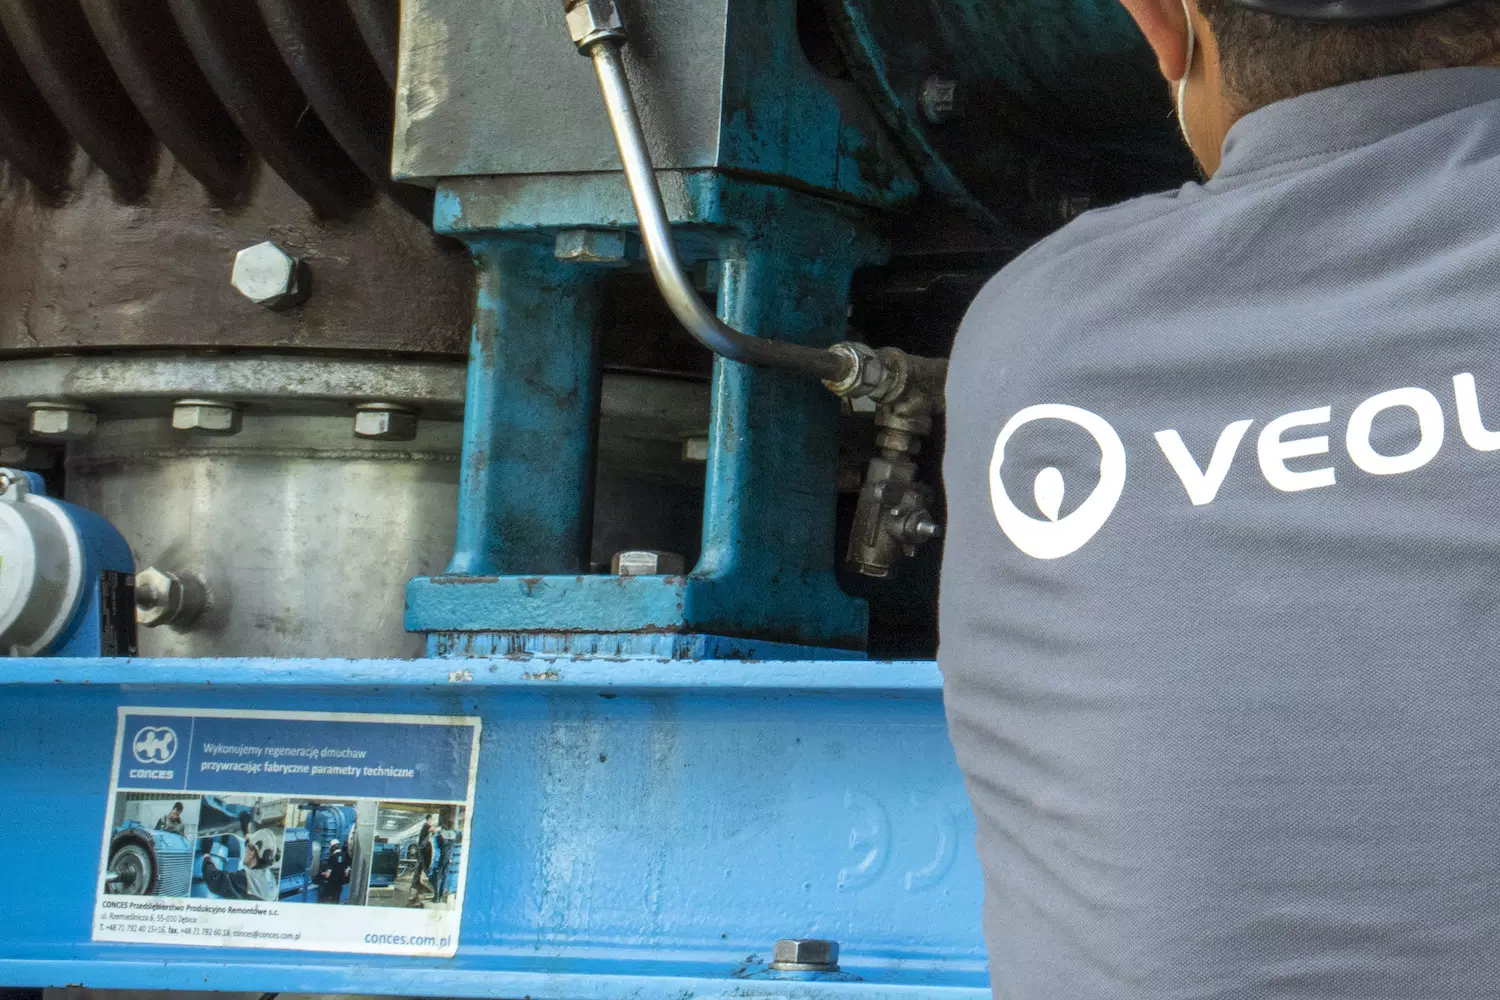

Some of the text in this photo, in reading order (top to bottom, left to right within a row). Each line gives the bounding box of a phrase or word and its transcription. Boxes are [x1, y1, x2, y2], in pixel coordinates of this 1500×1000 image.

[203, 743, 367, 760] Wykonujemy regenerację dmuchaw
[200, 761, 414, 778] przywracając fabryczne parametry techniczne
[102, 901, 128, 909] CONCES
[129, 902, 185, 911] Przedsiębiorstwo
[186, 904, 227, 914] Produkcyjno
[168, 926, 179, 934] fax.
[233, 929, 301, 941] conces@conces.com.pl
[364, 933, 451, 949] conces.com.pl
